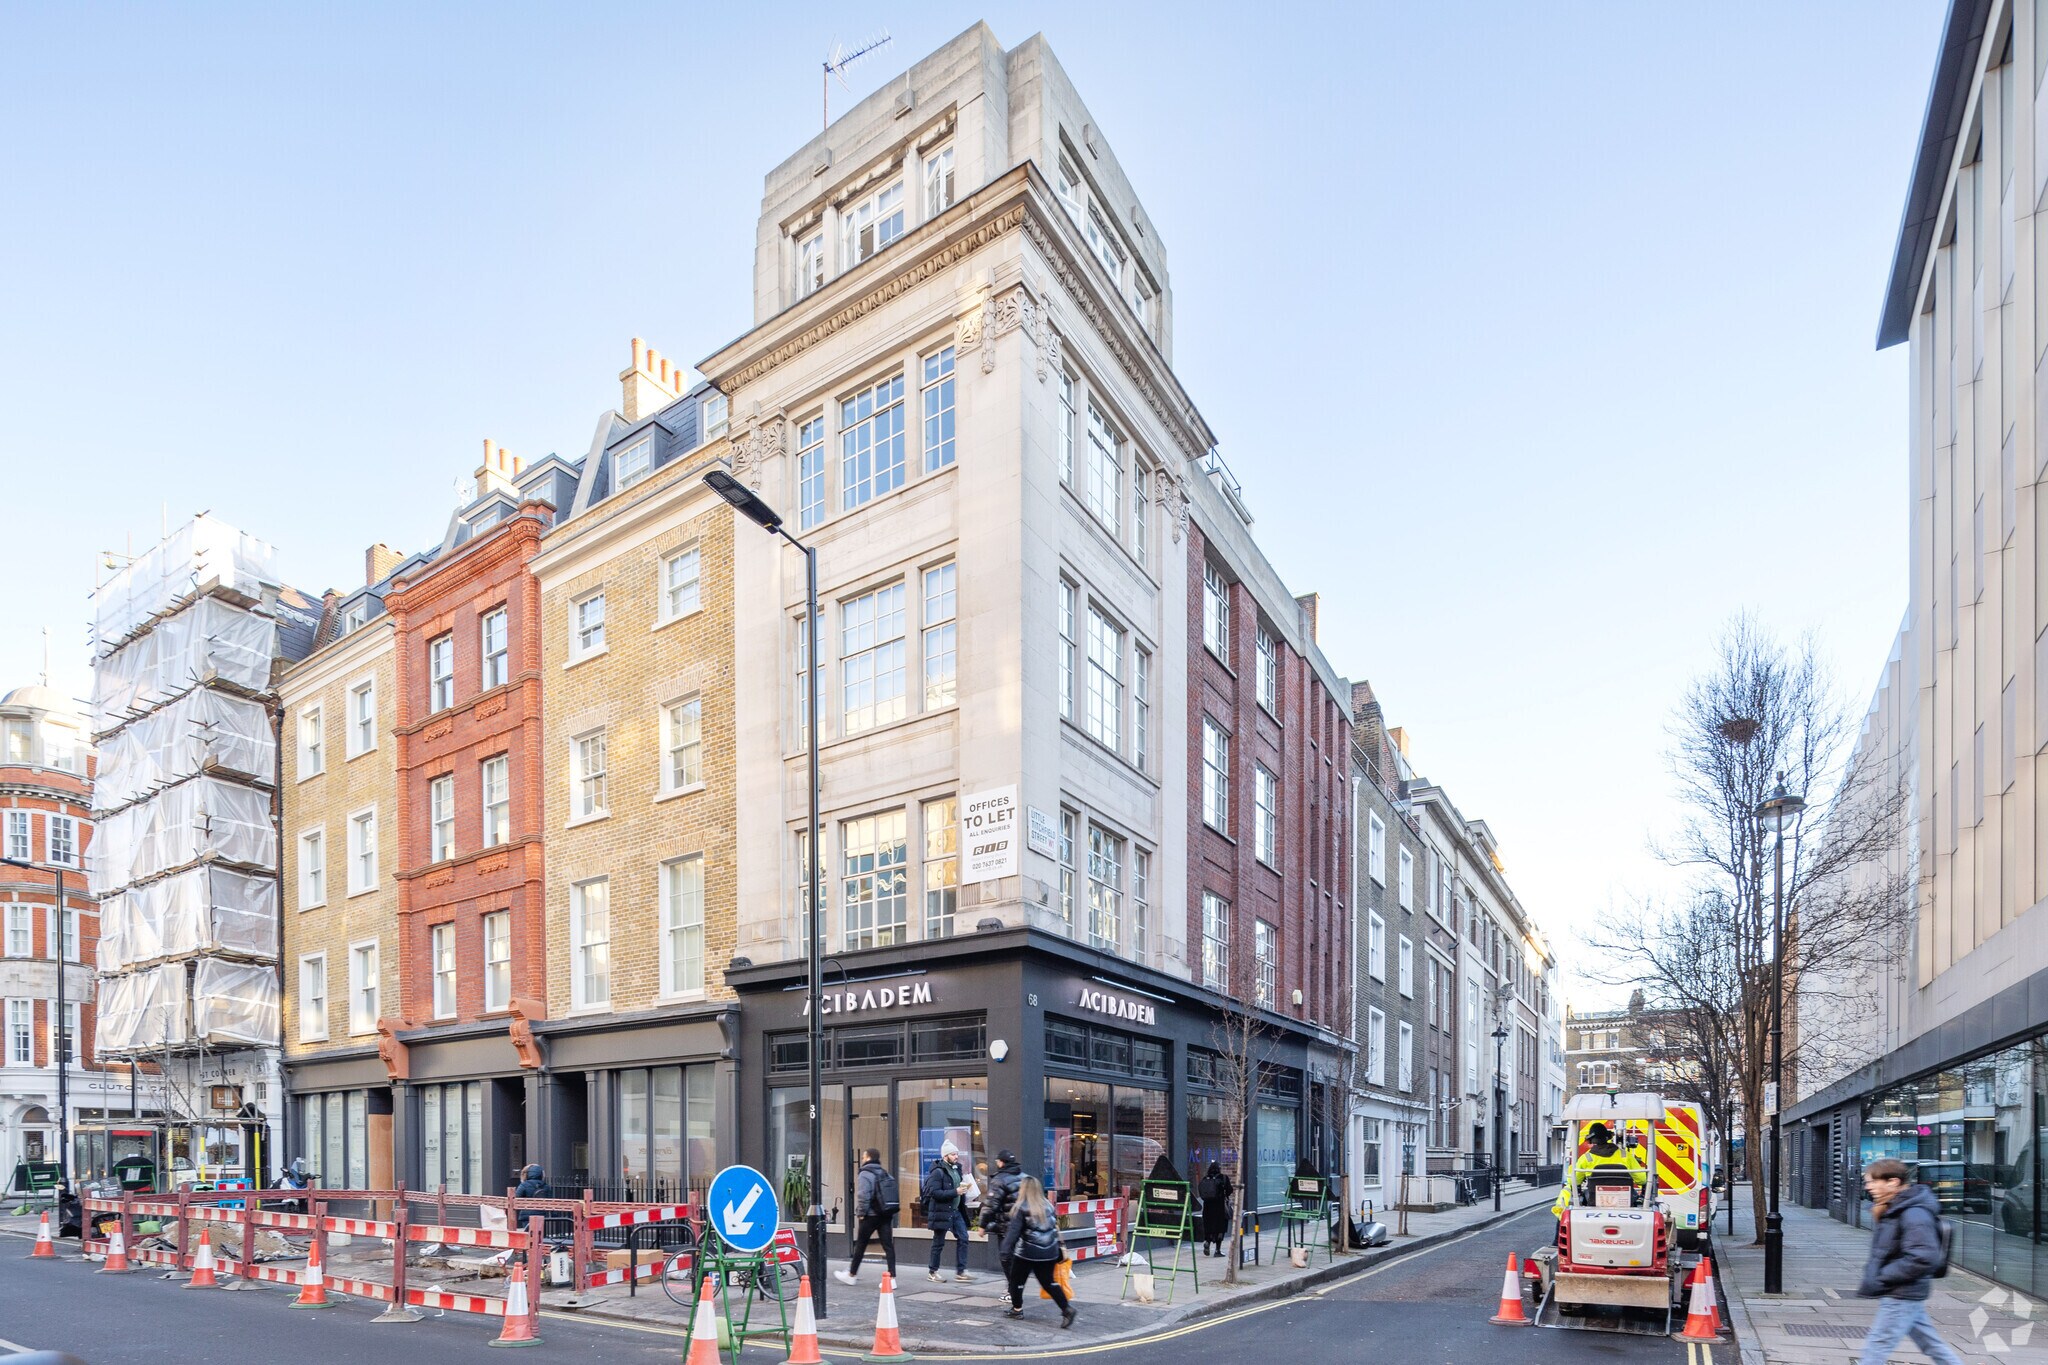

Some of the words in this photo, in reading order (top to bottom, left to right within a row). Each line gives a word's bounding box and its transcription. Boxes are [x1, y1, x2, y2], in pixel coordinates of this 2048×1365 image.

[969, 796, 1009, 812] OFFICES
[964, 815, 983, 829] TO
[988, 807, 1015, 824] LET
[1030, 810, 1046, 824] LITTLE
[980, 824, 1011, 836] ENQUIRIES
[1031, 830, 1047, 844] STREET
[973, 841, 1008, 856] RIB
[972, 862, 981, 870] 020
[1028, 993, 1038, 1007] 68
[1079, 988, 1155, 1025] ACIBADEM
